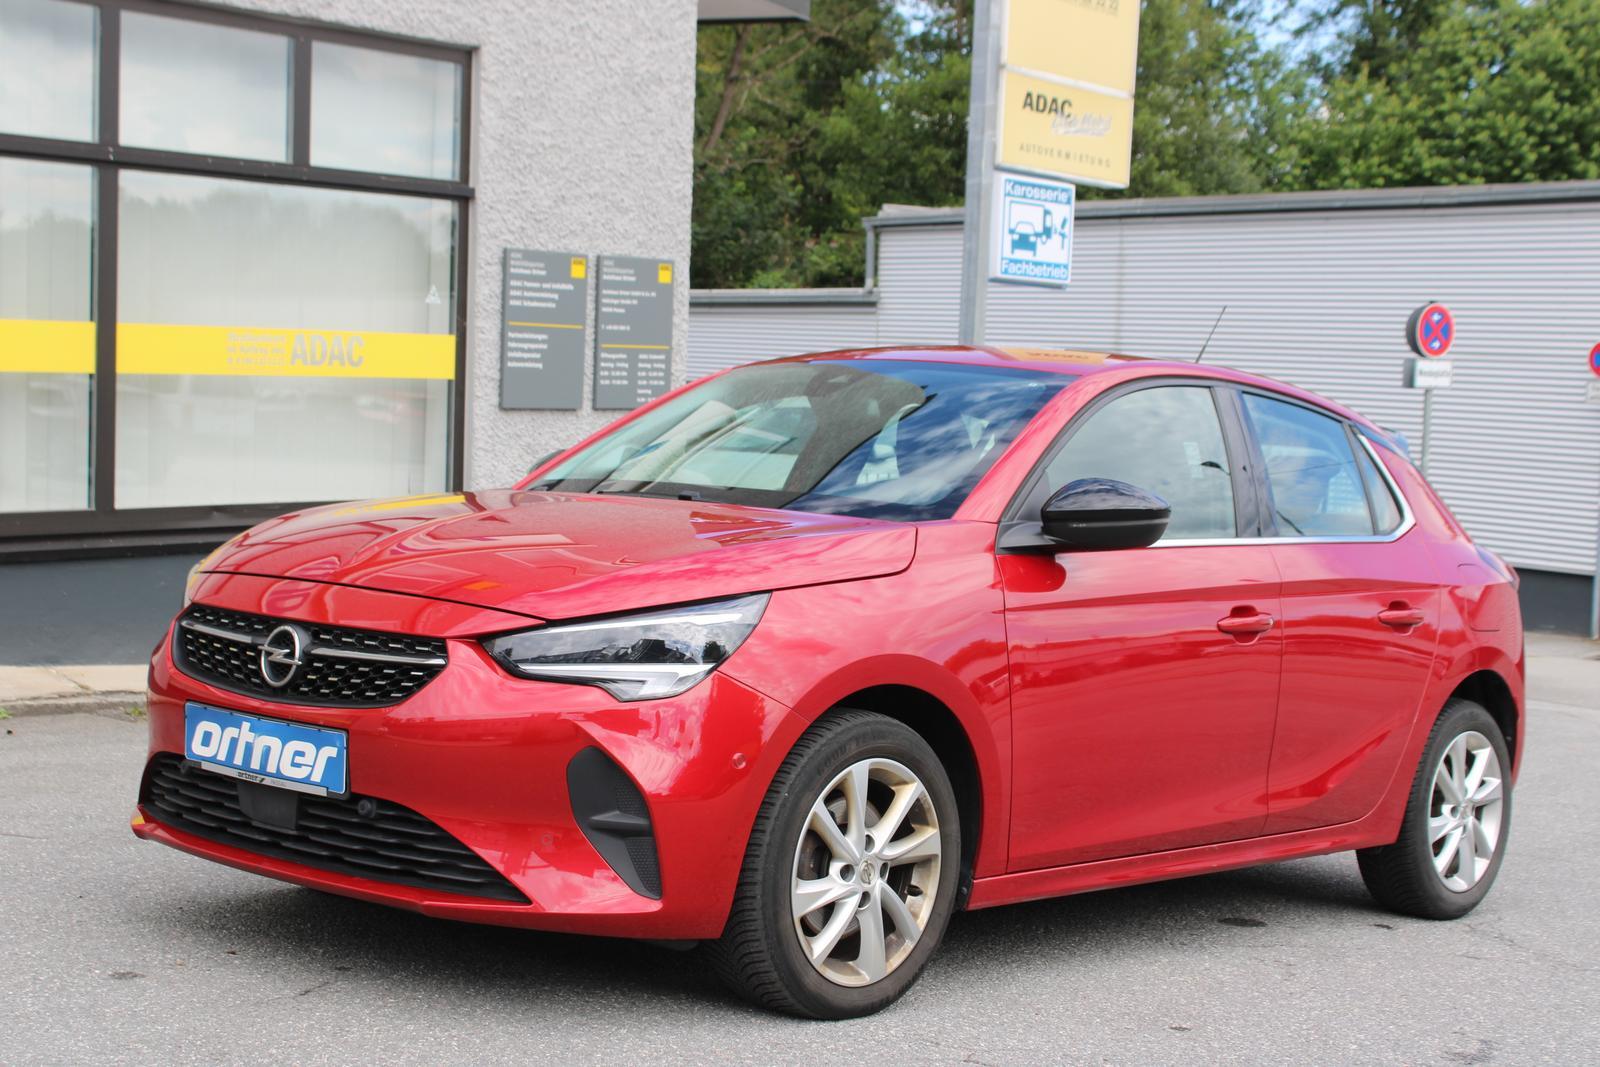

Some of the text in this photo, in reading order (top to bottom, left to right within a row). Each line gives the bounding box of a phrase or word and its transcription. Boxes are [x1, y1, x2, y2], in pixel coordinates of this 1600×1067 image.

[1022, 91, 1073, 118] ADAC
[1006, 181, 1069, 200] Karosserie
[1003, 262, 1067, 278] Fachbetrieb
[290, 333, 365, 368] ADAC
[191, 720, 338, 783] ortner
